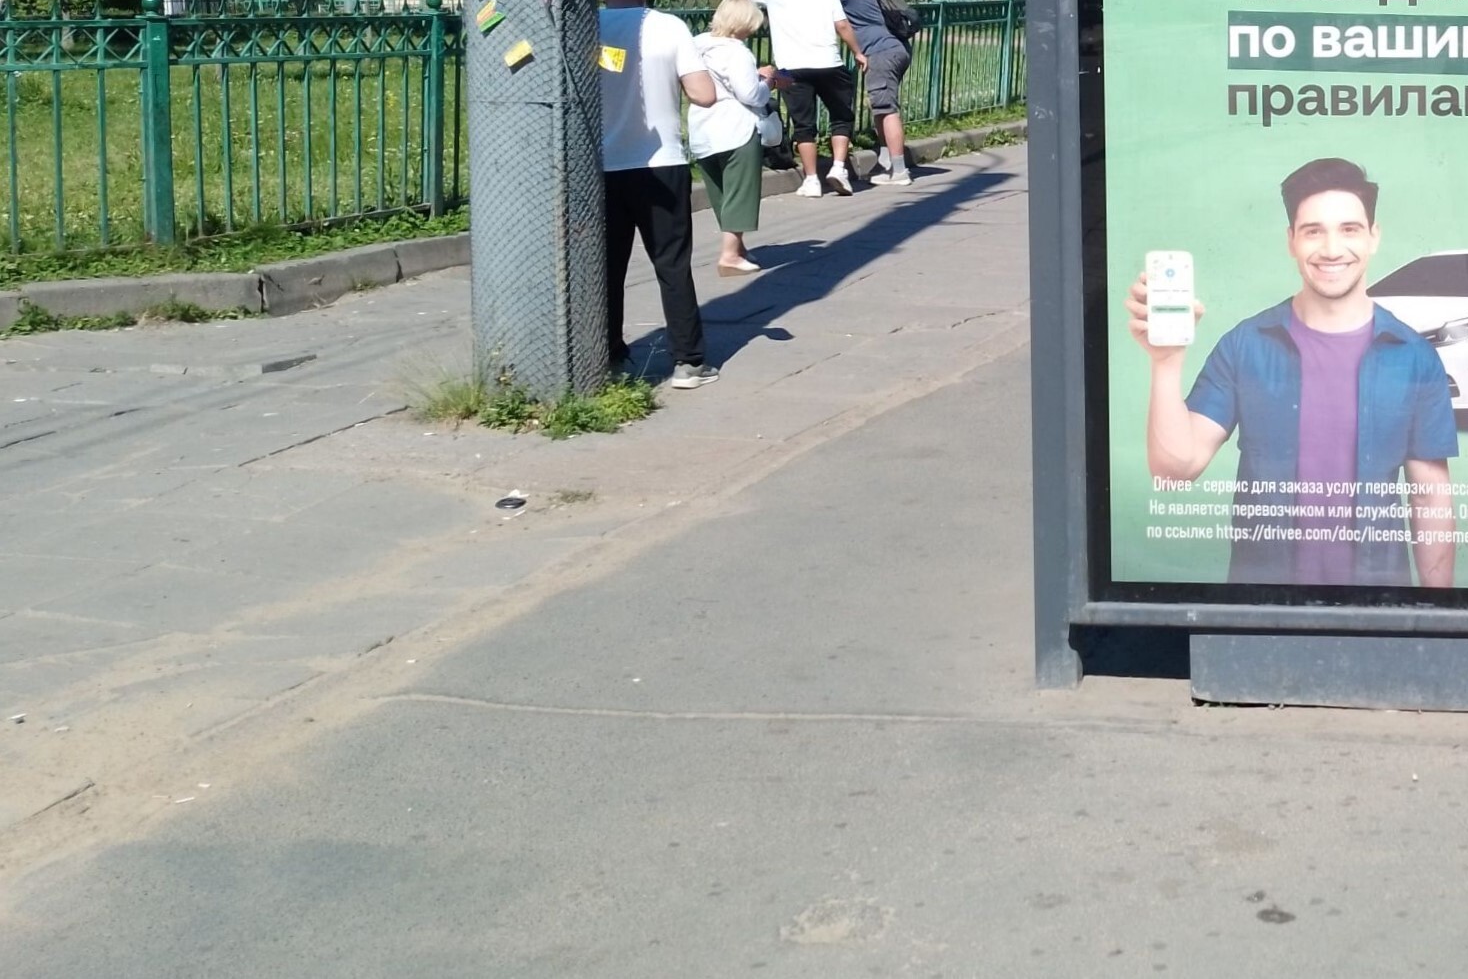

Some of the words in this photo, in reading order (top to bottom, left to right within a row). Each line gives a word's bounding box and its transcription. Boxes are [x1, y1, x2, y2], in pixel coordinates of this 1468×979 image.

[1228, 25, 1296, 58] по
[1153, 475, 1192, 492] Drivee
[1203, 480, 1249, 495] сервис
[1251, 481, 1276, 494] для
[1279, 481, 1323, 494] заказа
[1326, 482, 1362, 497] услуг
[1365, 482, 1434, 498] перевозки
[1149, 499, 1165, 515] Не
[1168, 503, 1229, 516] является
[1232, 504, 1324, 519] перевозчиком
[1328, 506, 1352, 518] или
[1355, 502, 1412, 521] службой
[1416, 505, 1456, 519] такси.
[1146, 526, 1162, 539] по
[1165, 526, 1213, 539] ссылке
